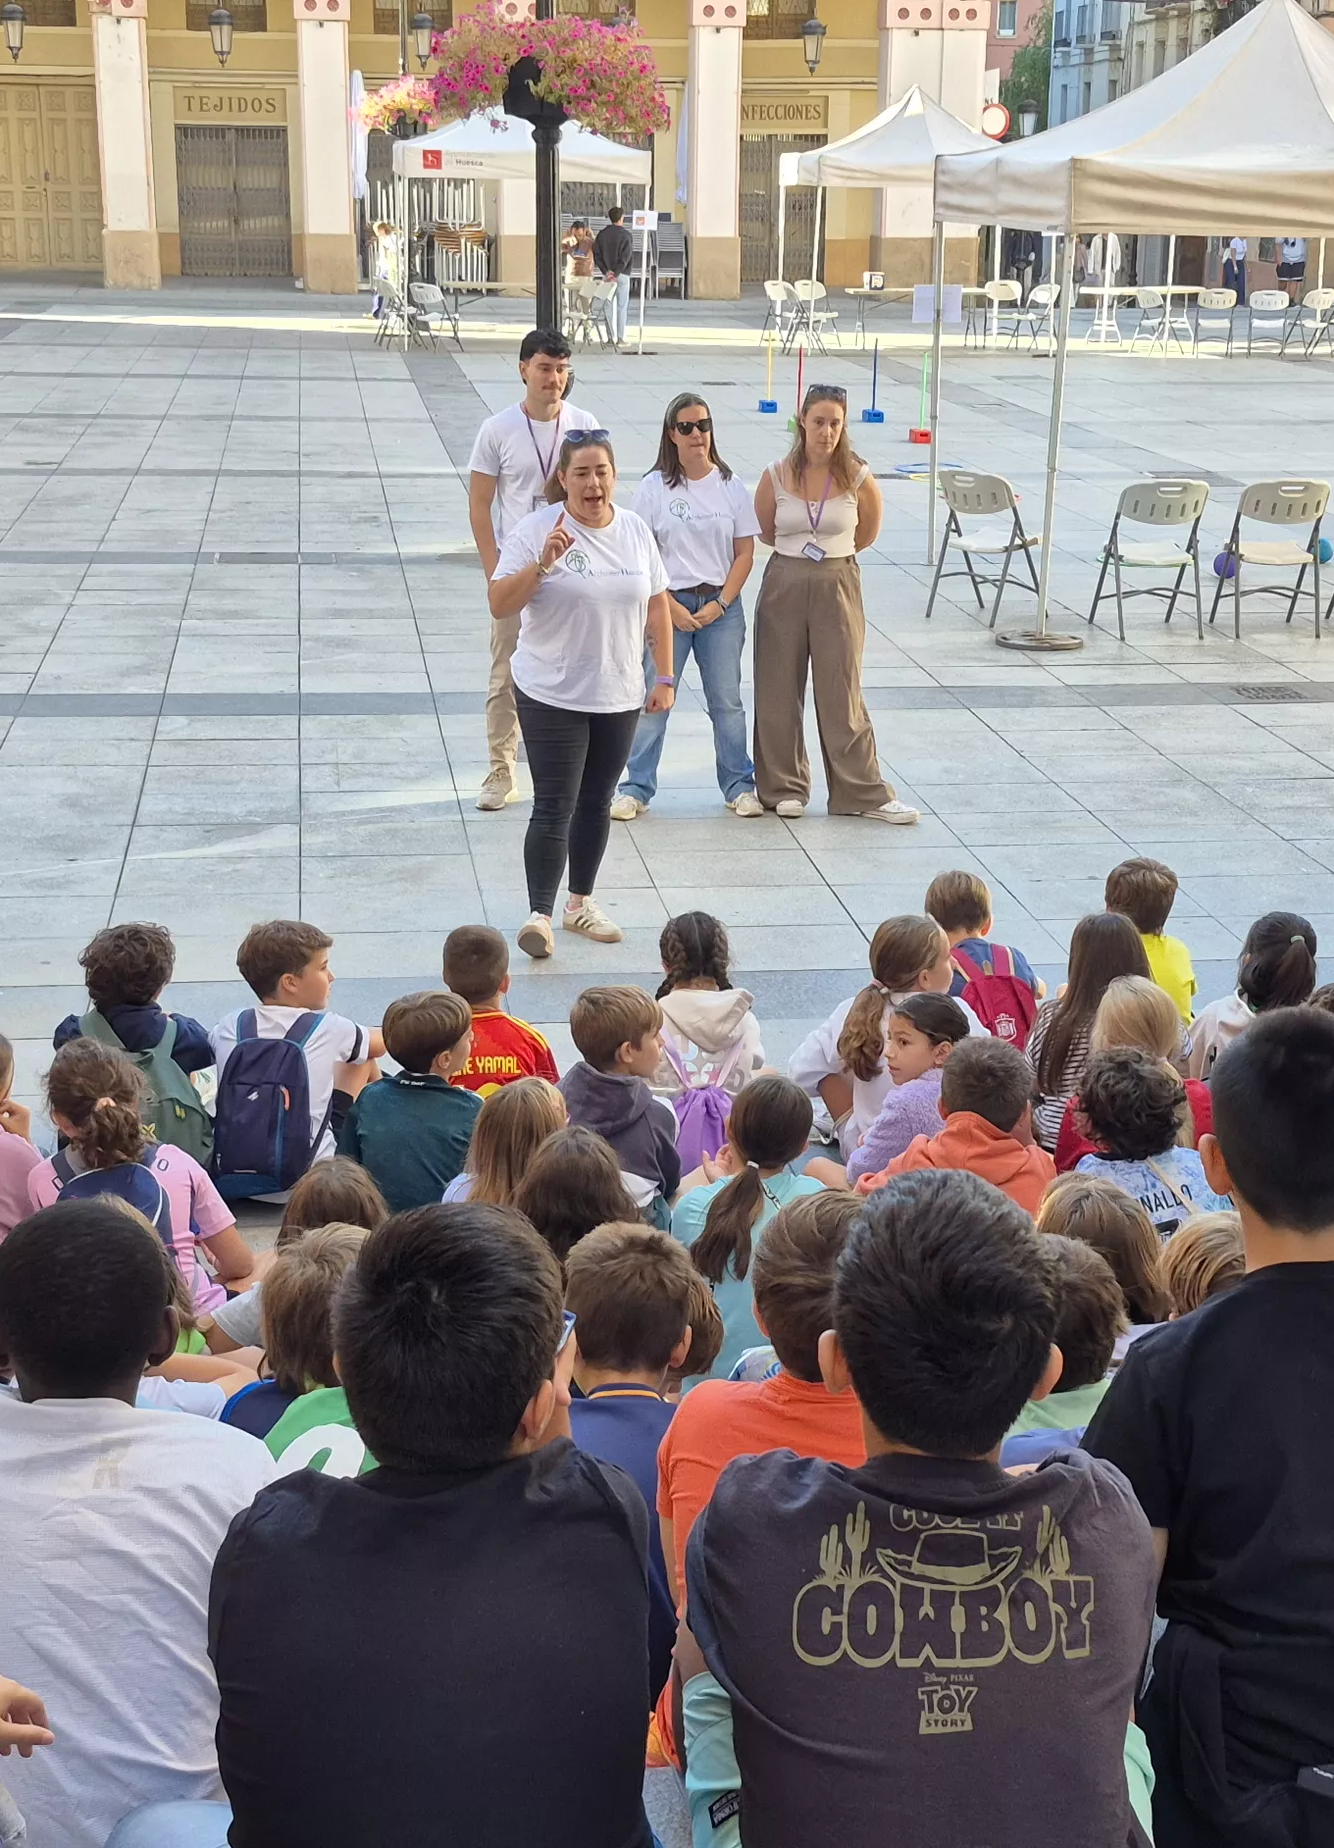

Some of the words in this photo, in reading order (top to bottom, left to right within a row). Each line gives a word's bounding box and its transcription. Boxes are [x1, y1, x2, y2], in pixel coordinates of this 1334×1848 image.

[183, 95, 277, 113] TEJIDOS
[742, 104, 821, 121] NFECCIONES
[456, 158, 484, 166] Huesca
[475, 1055, 522, 1075] YAMAL
[1138, 1183, 1193, 1213] NALDO
[792, 1576, 1095, 1668] COWBOY
[918, 1684, 979, 1716] TOY
[925, 1718, 967, 1728] STORY
